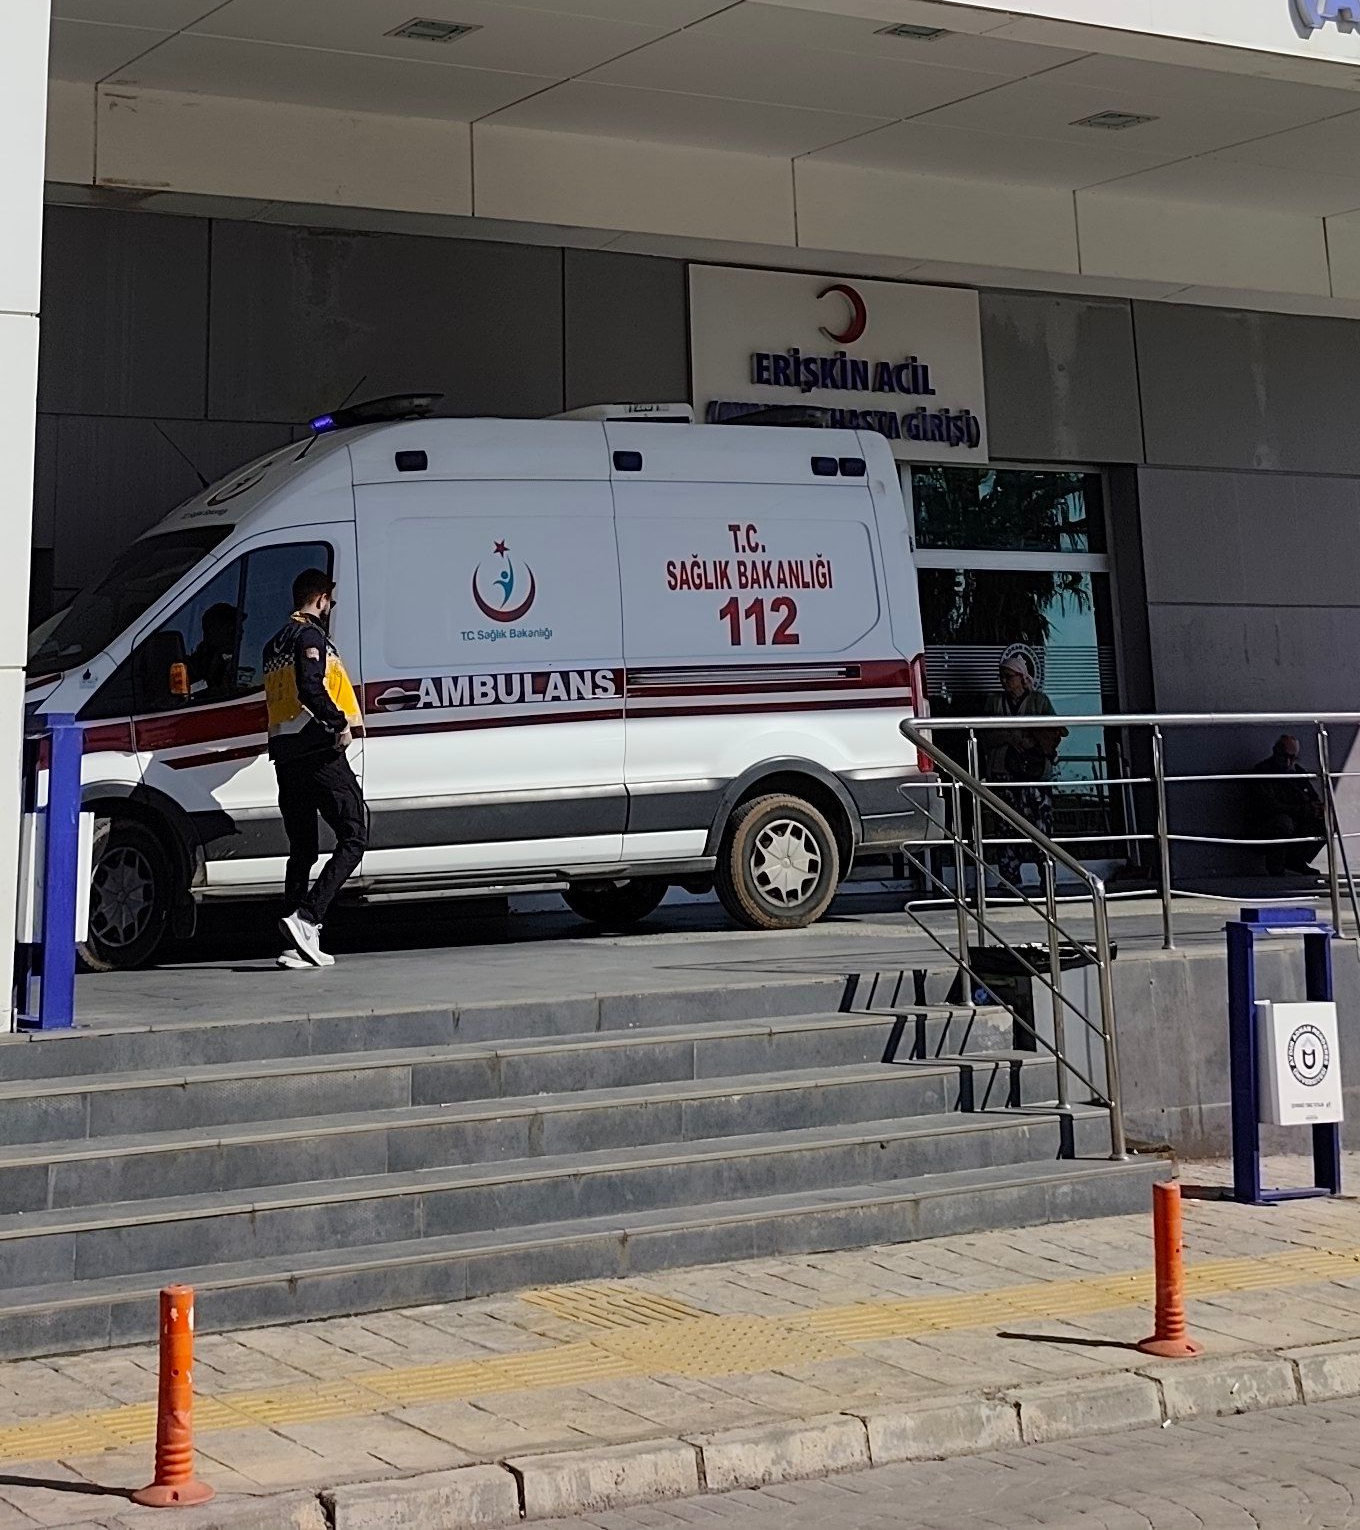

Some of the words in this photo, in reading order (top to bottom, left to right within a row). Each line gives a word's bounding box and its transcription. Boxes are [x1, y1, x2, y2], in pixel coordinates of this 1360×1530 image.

[751, 347, 869, 394] ERİŞKİN
[872, 356, 936, 396] ACİL
[901, 406, 981, 448] GİRİŞİ)
[728, 523, 766, 553] T.C.
[666, 553, 732, 590] SAĞLIK
[736, 552, 833, 589] BAKANLIĞI
[477, 630, 507, 642] Sağlık
[509, 627, 553, 640] Bakanlığı
[719, 596, 800, 646] 112
[416, 669, 616, 708] AMBULANS
